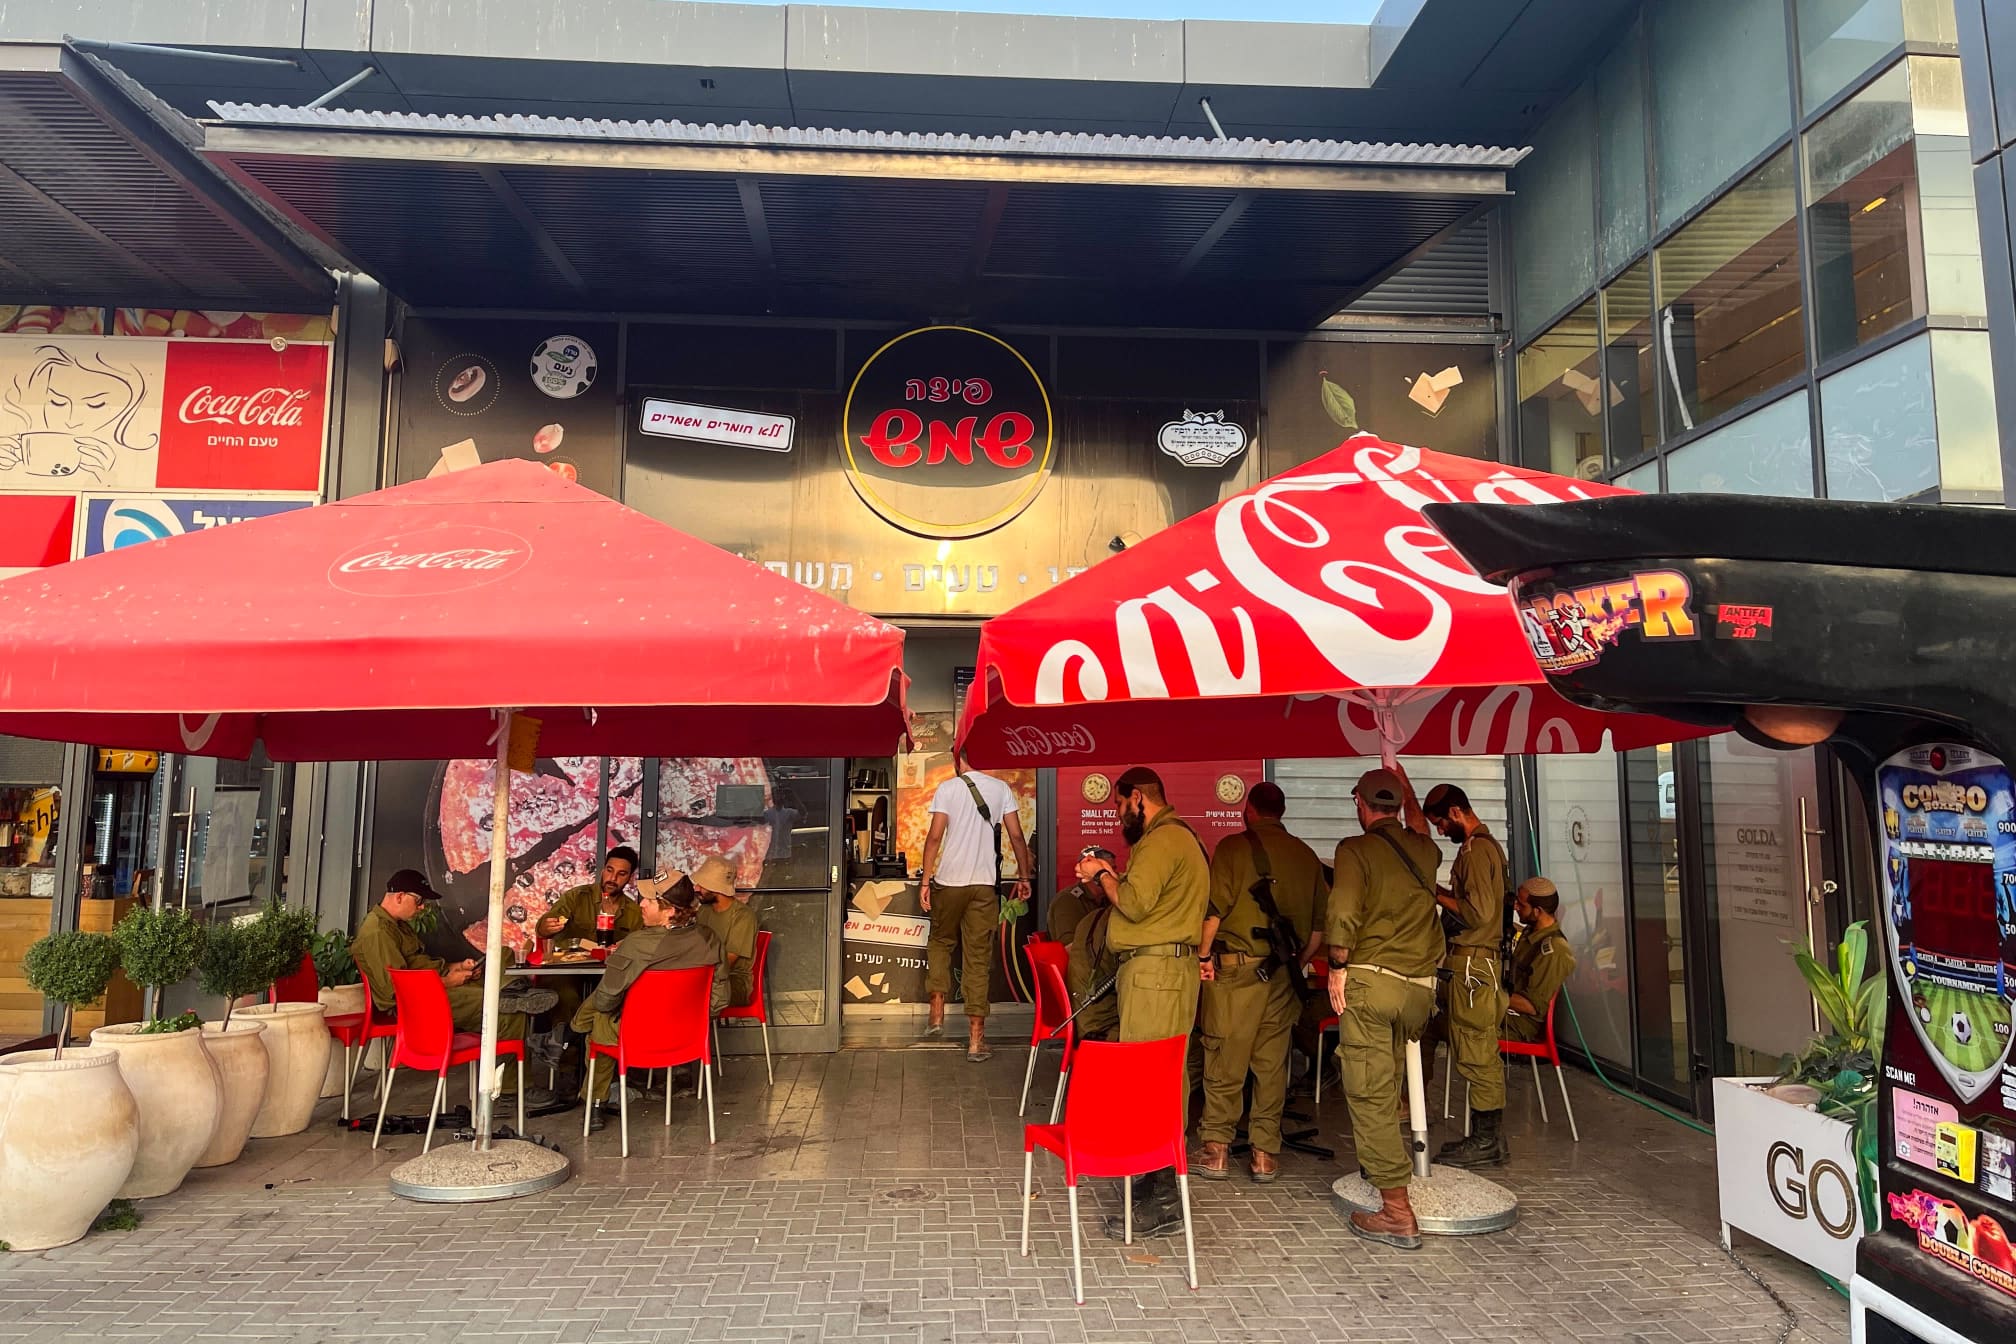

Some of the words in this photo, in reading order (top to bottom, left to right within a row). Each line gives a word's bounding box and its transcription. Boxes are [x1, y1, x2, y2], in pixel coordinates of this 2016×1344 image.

[906, 377, 992, 405] פיצה
[179, 386, 311, 426] Coca-Cola
[650, 413, 702, 428] משמרים
[706, 420, 753, 434] חומרים
[758, 423, 784, 438] ללא
[860, 408, 1034, 468] שמש
[207, 435, 244, 447] החיים
[249, 436, 279, 448] טעם
[339, 549, 520, 573] Coca-Cola
[903, 563, 1000, 593] טעים
[1726, 607, 1766, 618] ANTIFA
[1081, 809, 1102, 818] SMALL
[1103, 809, 1117, 818] PIZZ
[1205, 810, 1225, 818] אישית
[1226, 810, 1242, 818] פיצה
[1104, 820, 1114, 828] top
[1572, 821, 1583, 847] G
[1736, 827, 1778, 847] GOLDA
[862, 922, 900, 936] חומרים
[904, 924, 925, 937] ללא
[855, 952, 883, 965] טעים
[1930, 973, 1986, 994] TOURNAMENT
[1994, 1022, 2010, 1035] 100
[1885, 1065, 1903, 1082] SCAN
[1903, 1071, 1916, 1087] ME!
[1913, 1097, 1940, 1117] אזהרה!
[1920, 1232, 1971, 1270] DOUBLE
